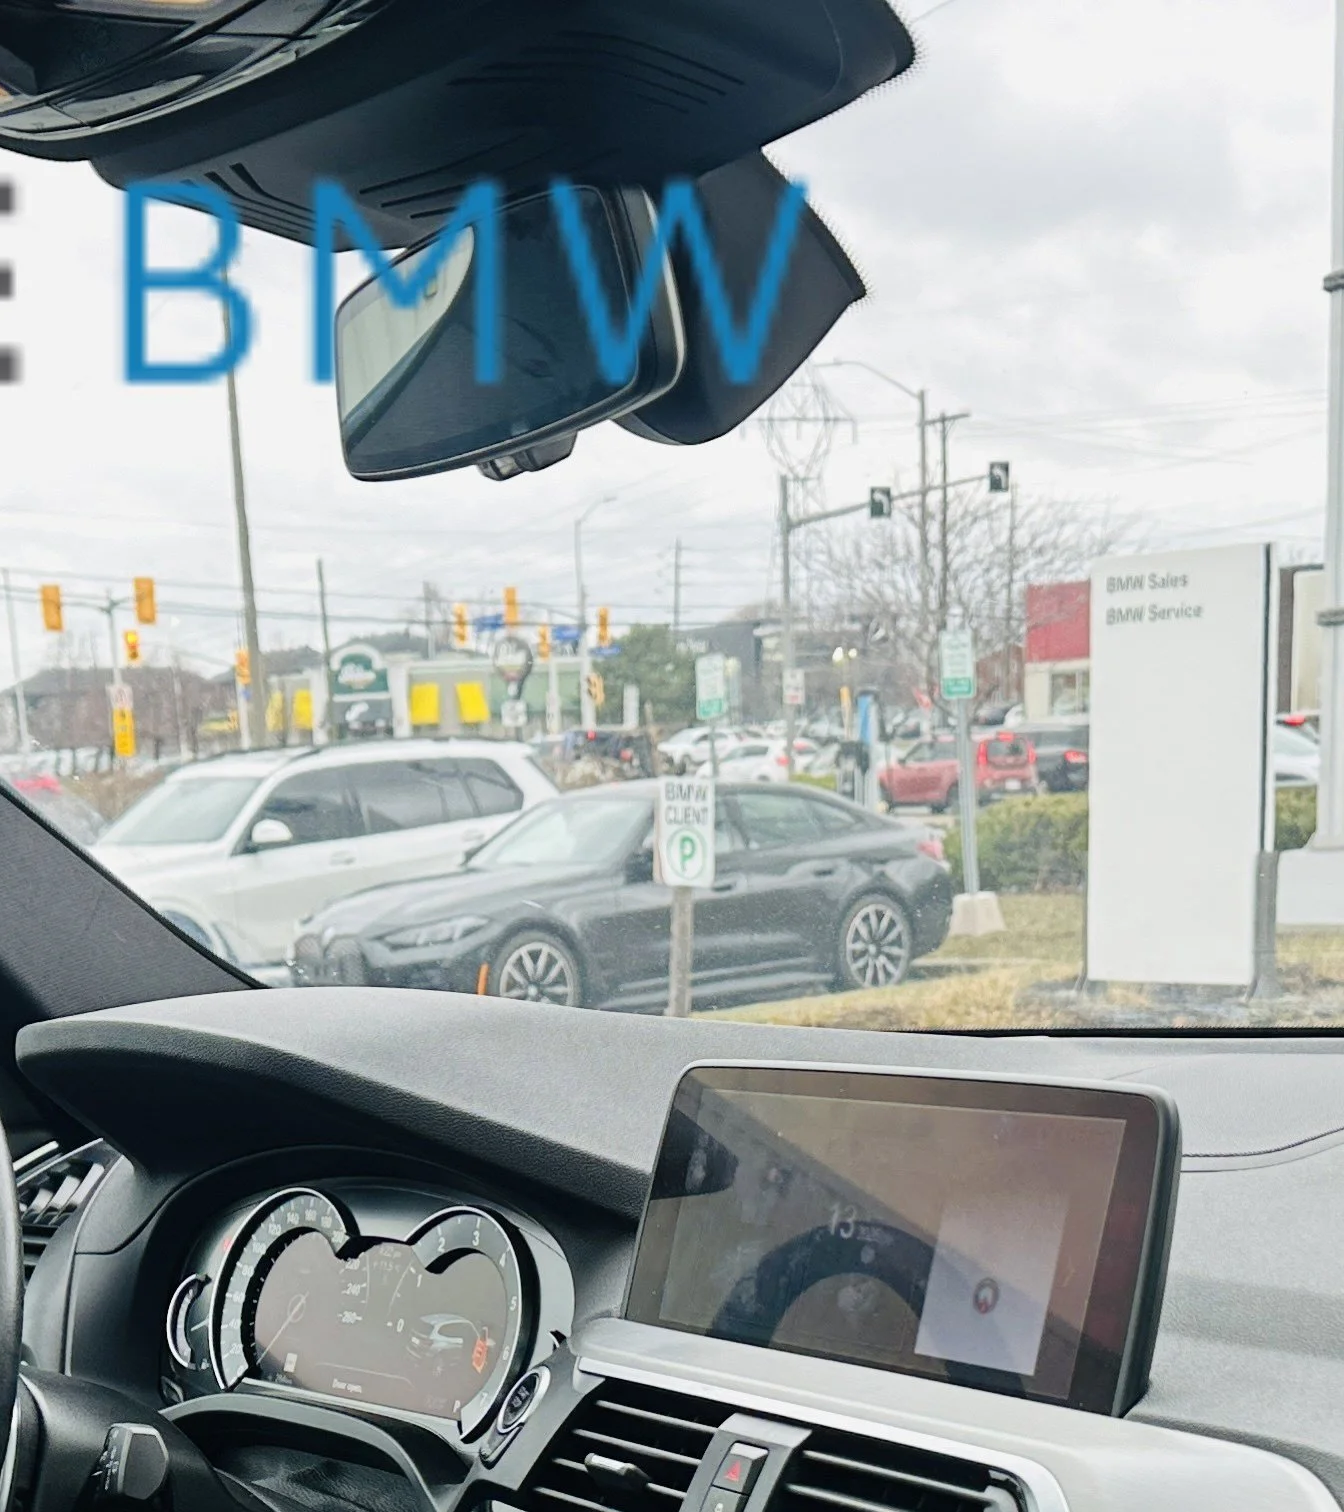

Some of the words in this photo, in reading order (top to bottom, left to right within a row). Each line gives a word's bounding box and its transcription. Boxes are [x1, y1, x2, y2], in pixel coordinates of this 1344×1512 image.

[1106, 575, 1144, 594] BMW
[1147, 571, 1189, 590] Sales
[1106, 605, 1144, 626] BMW
[1147, 603, 1203, 622] Service
